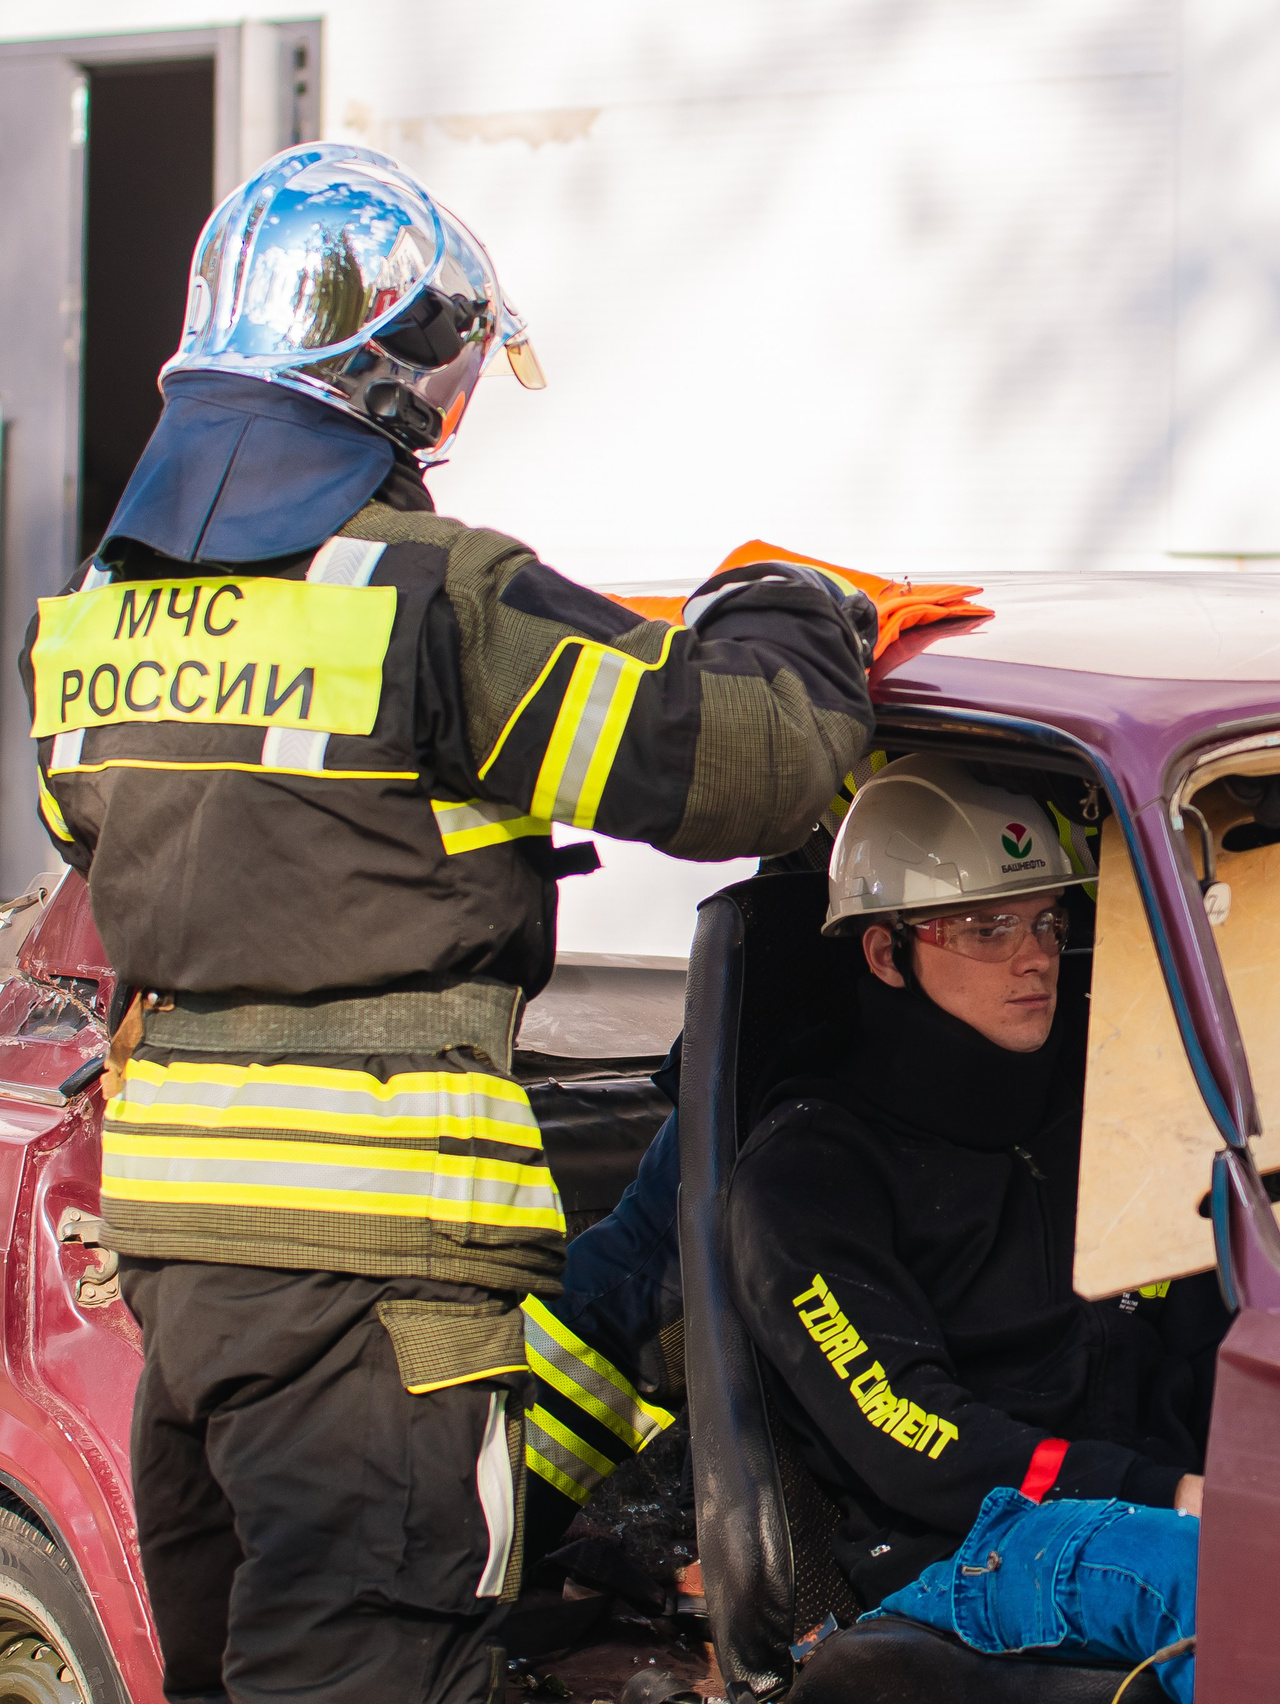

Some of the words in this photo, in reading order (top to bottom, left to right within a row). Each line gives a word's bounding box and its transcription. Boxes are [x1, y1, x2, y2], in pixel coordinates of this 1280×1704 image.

[112, 584, 245, 641] МЧС
[60, 660, 316, 724] РОССИИ
[1001, 859, 1046, 873] БАШНЕФТЬ
[792, 1273, 869, 1380] TIDAL
